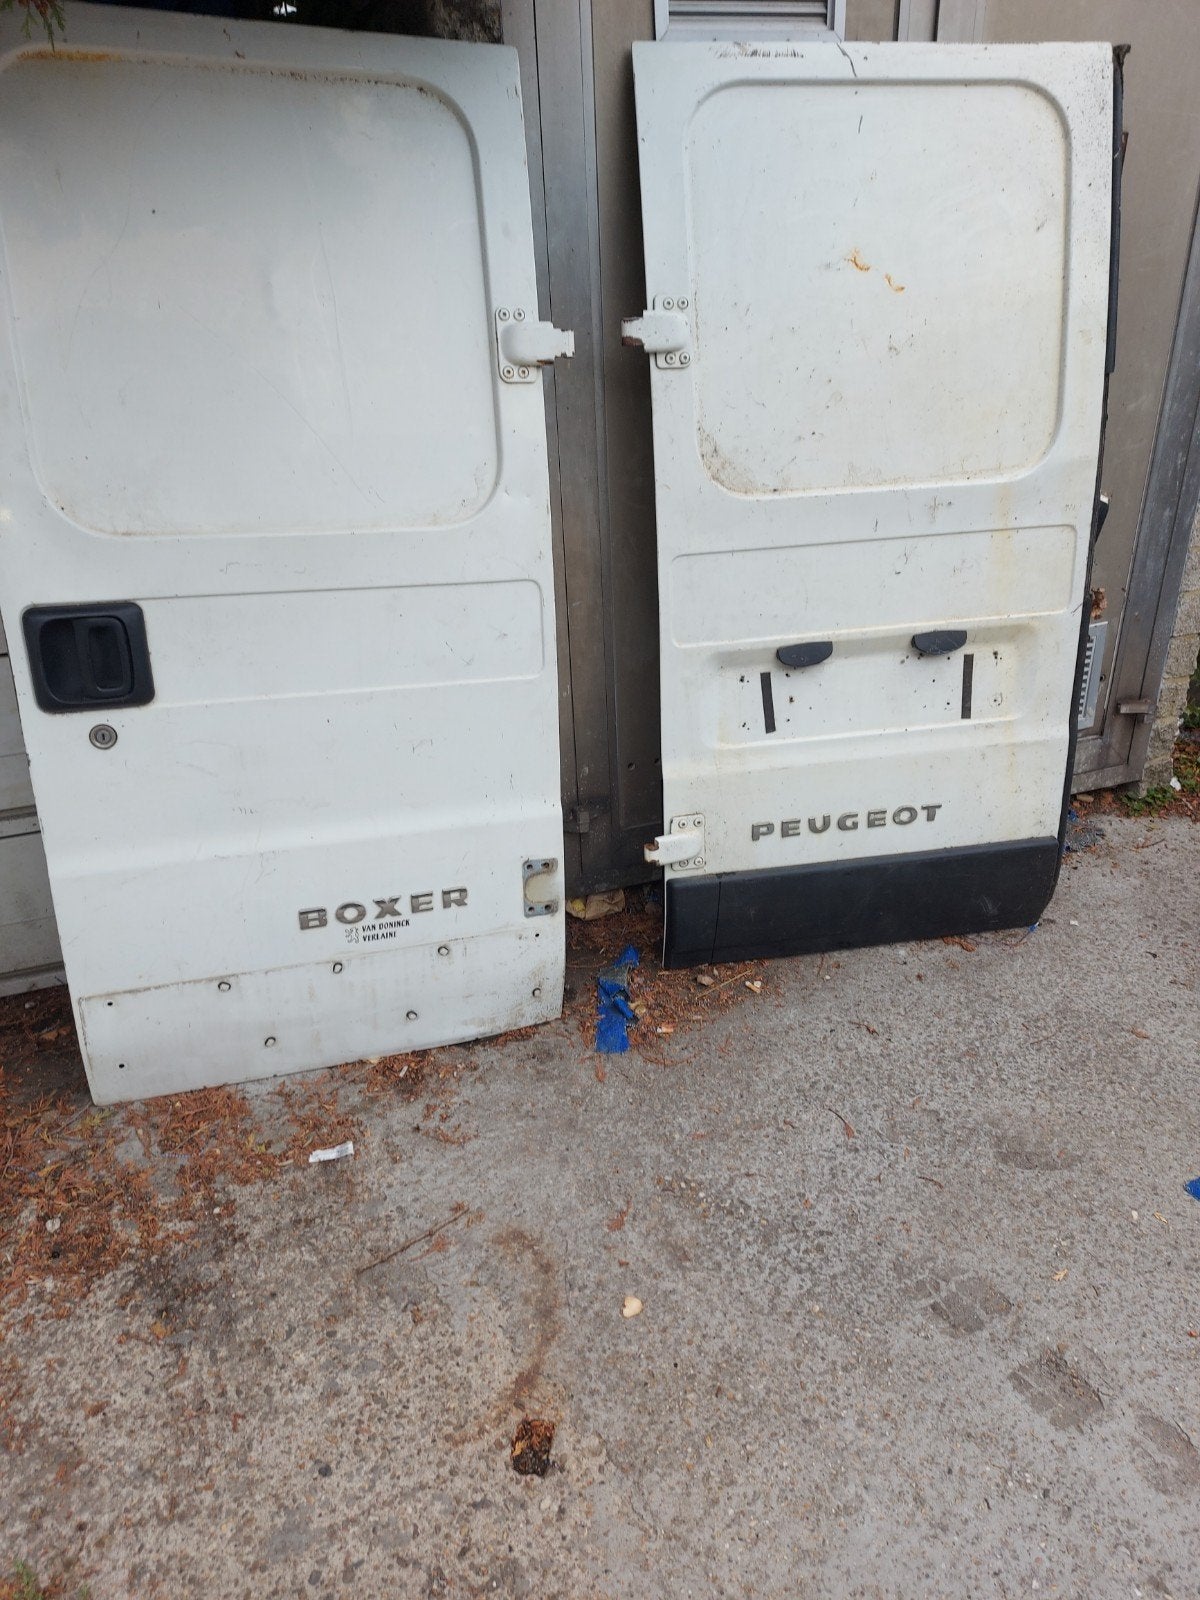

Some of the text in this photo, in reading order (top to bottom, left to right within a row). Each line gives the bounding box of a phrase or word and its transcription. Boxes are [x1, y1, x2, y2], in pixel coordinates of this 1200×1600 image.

[751, 803, 943, 842] PEUGEOT
[298, 885, 469, 931] BOXER
[362, 918, 410, 932] VAN DONINCK
